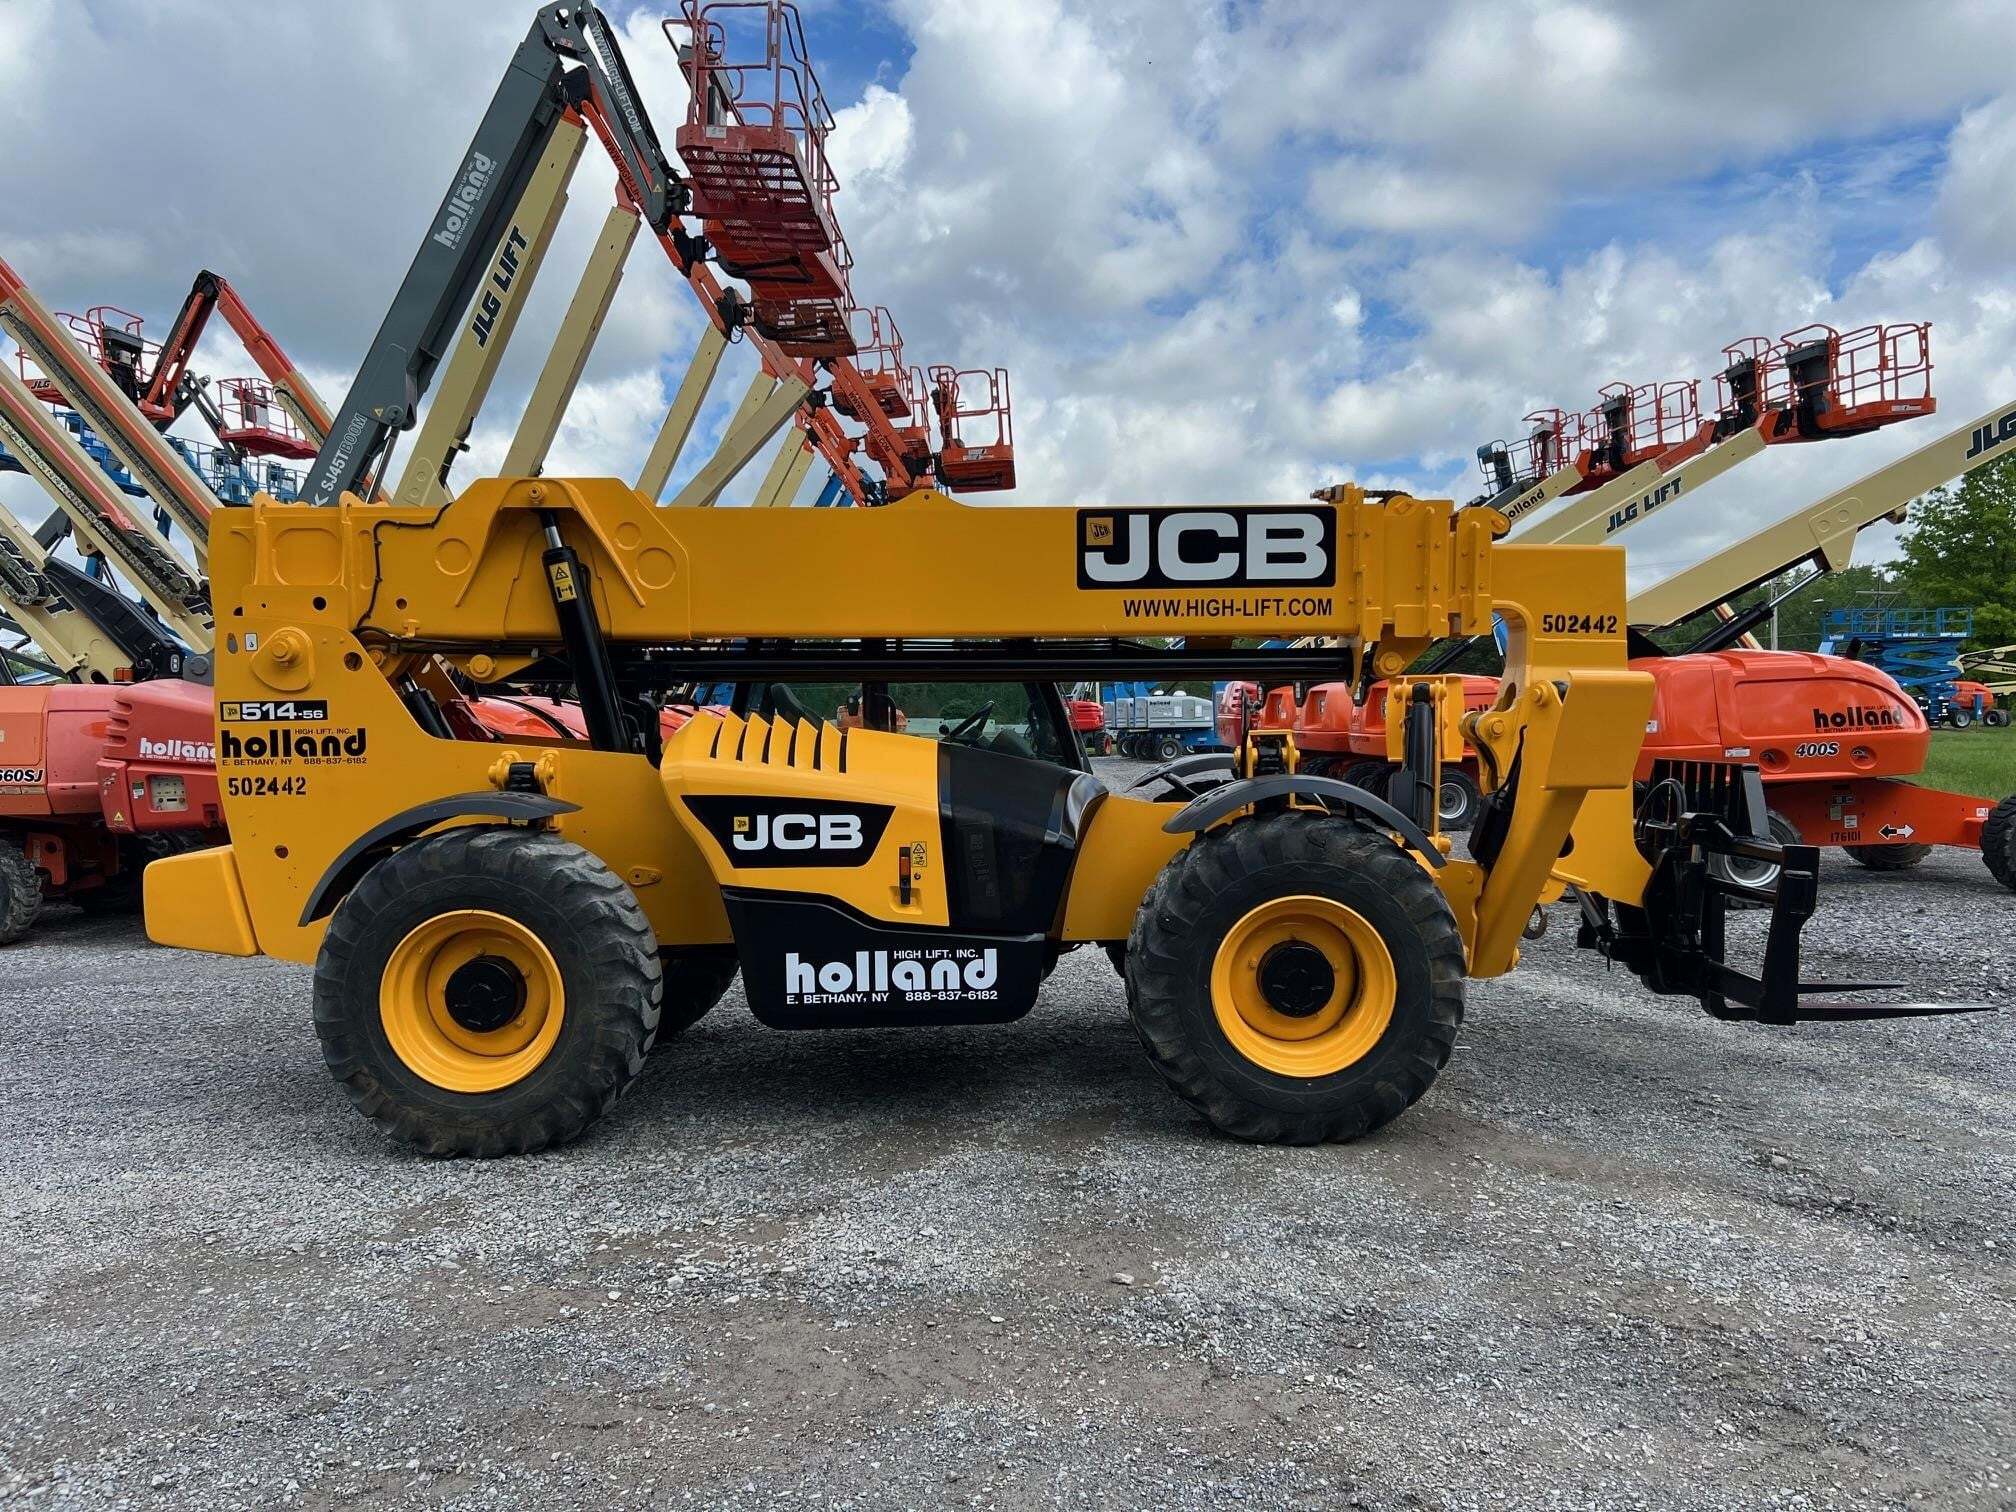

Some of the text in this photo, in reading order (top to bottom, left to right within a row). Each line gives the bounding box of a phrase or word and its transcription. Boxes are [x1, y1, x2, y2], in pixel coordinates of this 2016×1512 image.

[591, 25, 643, 135] WWW.HIGH-LIFT.COM
[433, 151, 491, 248] holland
[471, 225, 528, 349] JLG LIFT
[31, 380, 51, 390] JLG
[1508, 488, 1545, 518] olland
[1606, 476, 1682, 534] JLG LIFT
[1091, 523, 1110, 539] JCB
[1085, 512, 1328, 582] JCB
[1123, 598, 1333, 618] WWW.HIGH-LIFT.COM
[1542, 614, 1618, 634] 502442
[241, 702, 324, 720] 514-56
[1813, 705, 1904, 729] holland
[221, 727, 367, 759] holland
[1795, 742, 1840, 758] 400S
[303, 757, 368, 765] 888-837-6182
[228, 776, 307, 796] 502442
[733, 814, 864, 850] JCB
[893, 949, 979, 960] HIGH LIFT, INC.
[785, 948, 998, 994] holland
[786, 990, 998, 1005] E. BETHANY, NY 888-837-6182
